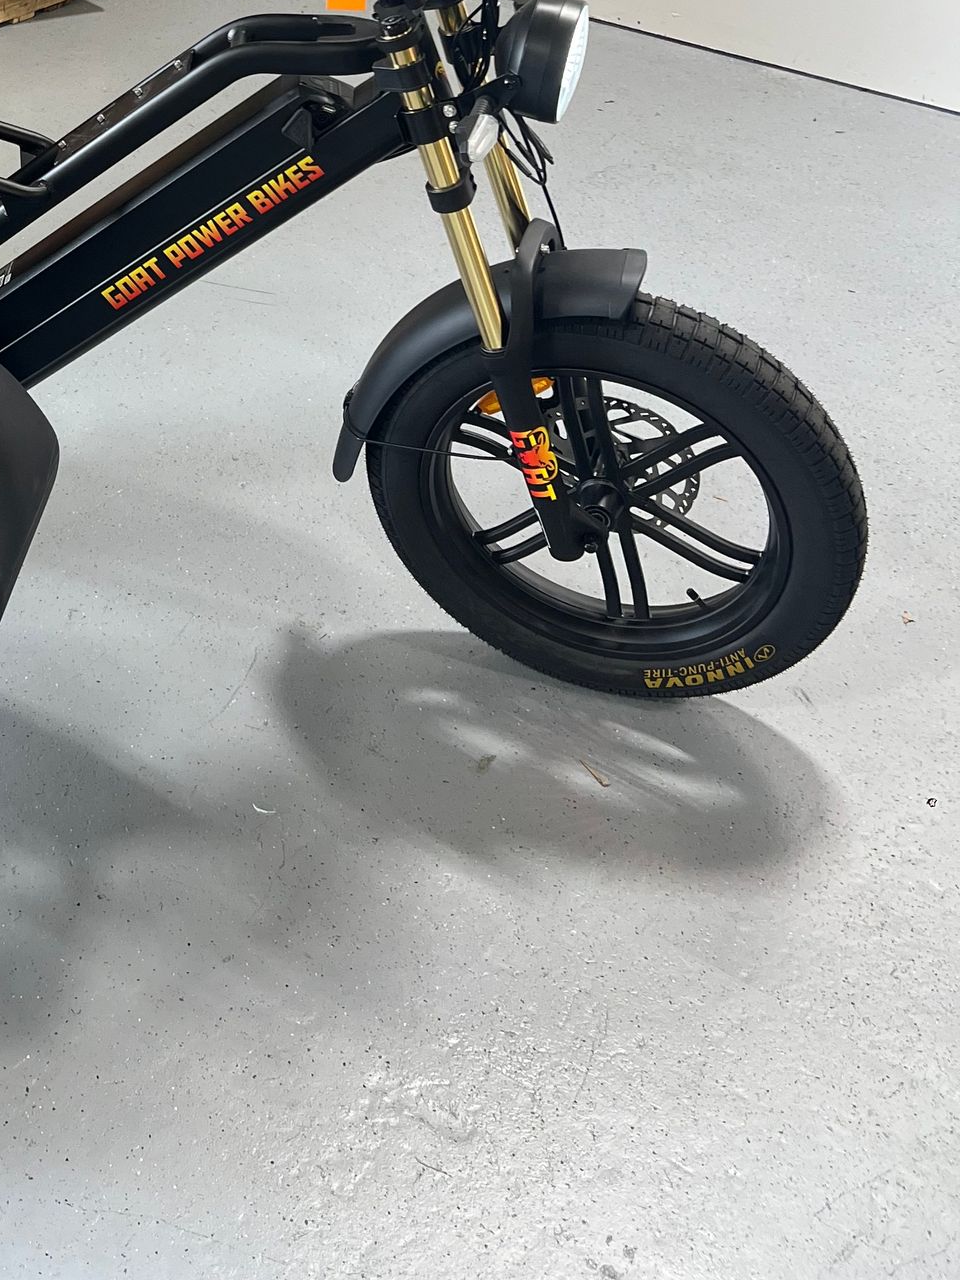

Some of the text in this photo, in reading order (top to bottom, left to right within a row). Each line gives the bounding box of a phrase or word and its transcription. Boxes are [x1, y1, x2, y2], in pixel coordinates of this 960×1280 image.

[101, 154, 326, 311] GOAT POWER BIKES
[643, 648, 746, 679] ANTI-PUNC-TIRE
[643, 656, 755, 689] INNOVA
